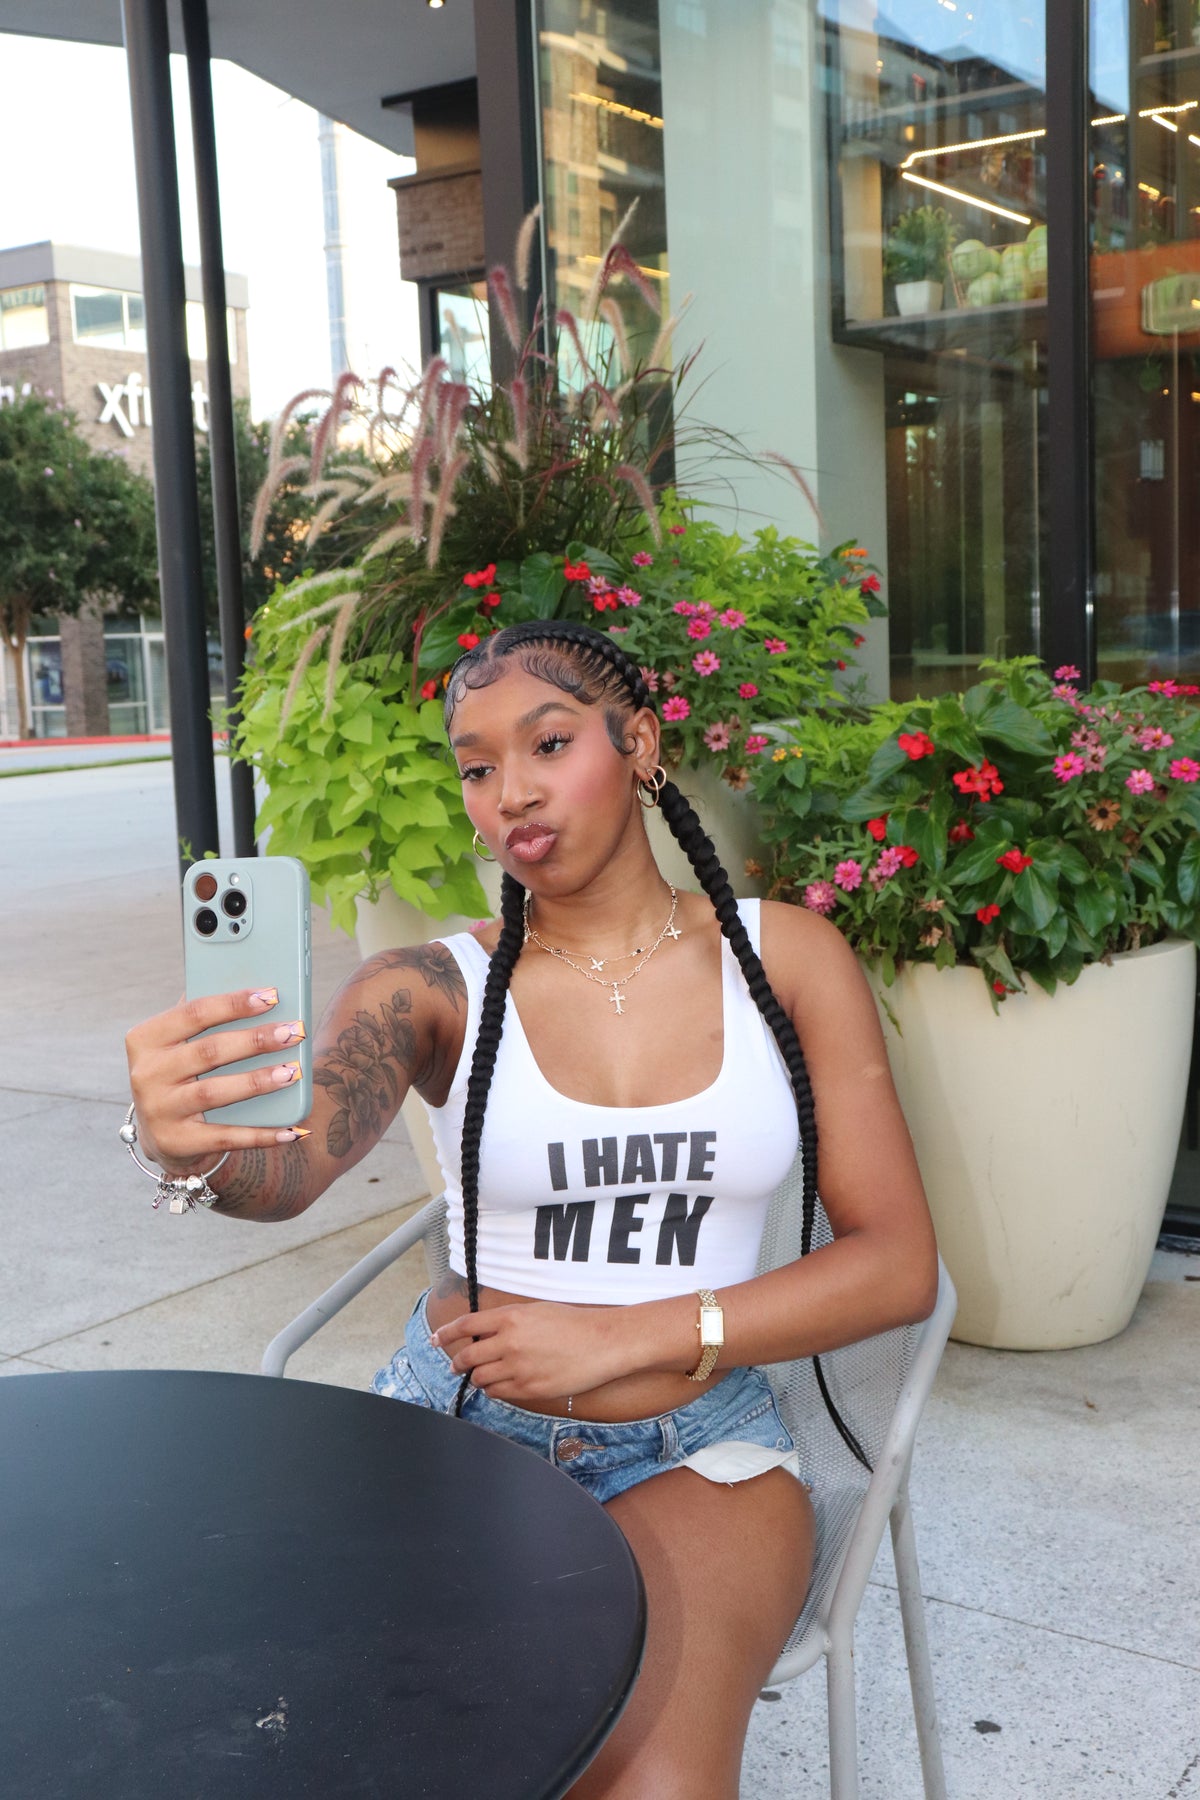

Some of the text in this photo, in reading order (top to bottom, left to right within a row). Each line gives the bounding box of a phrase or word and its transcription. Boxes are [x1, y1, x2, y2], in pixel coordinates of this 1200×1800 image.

[547, 1131, 717, 1191] I HATE
[534, 1193, 715, 1267] MEN
